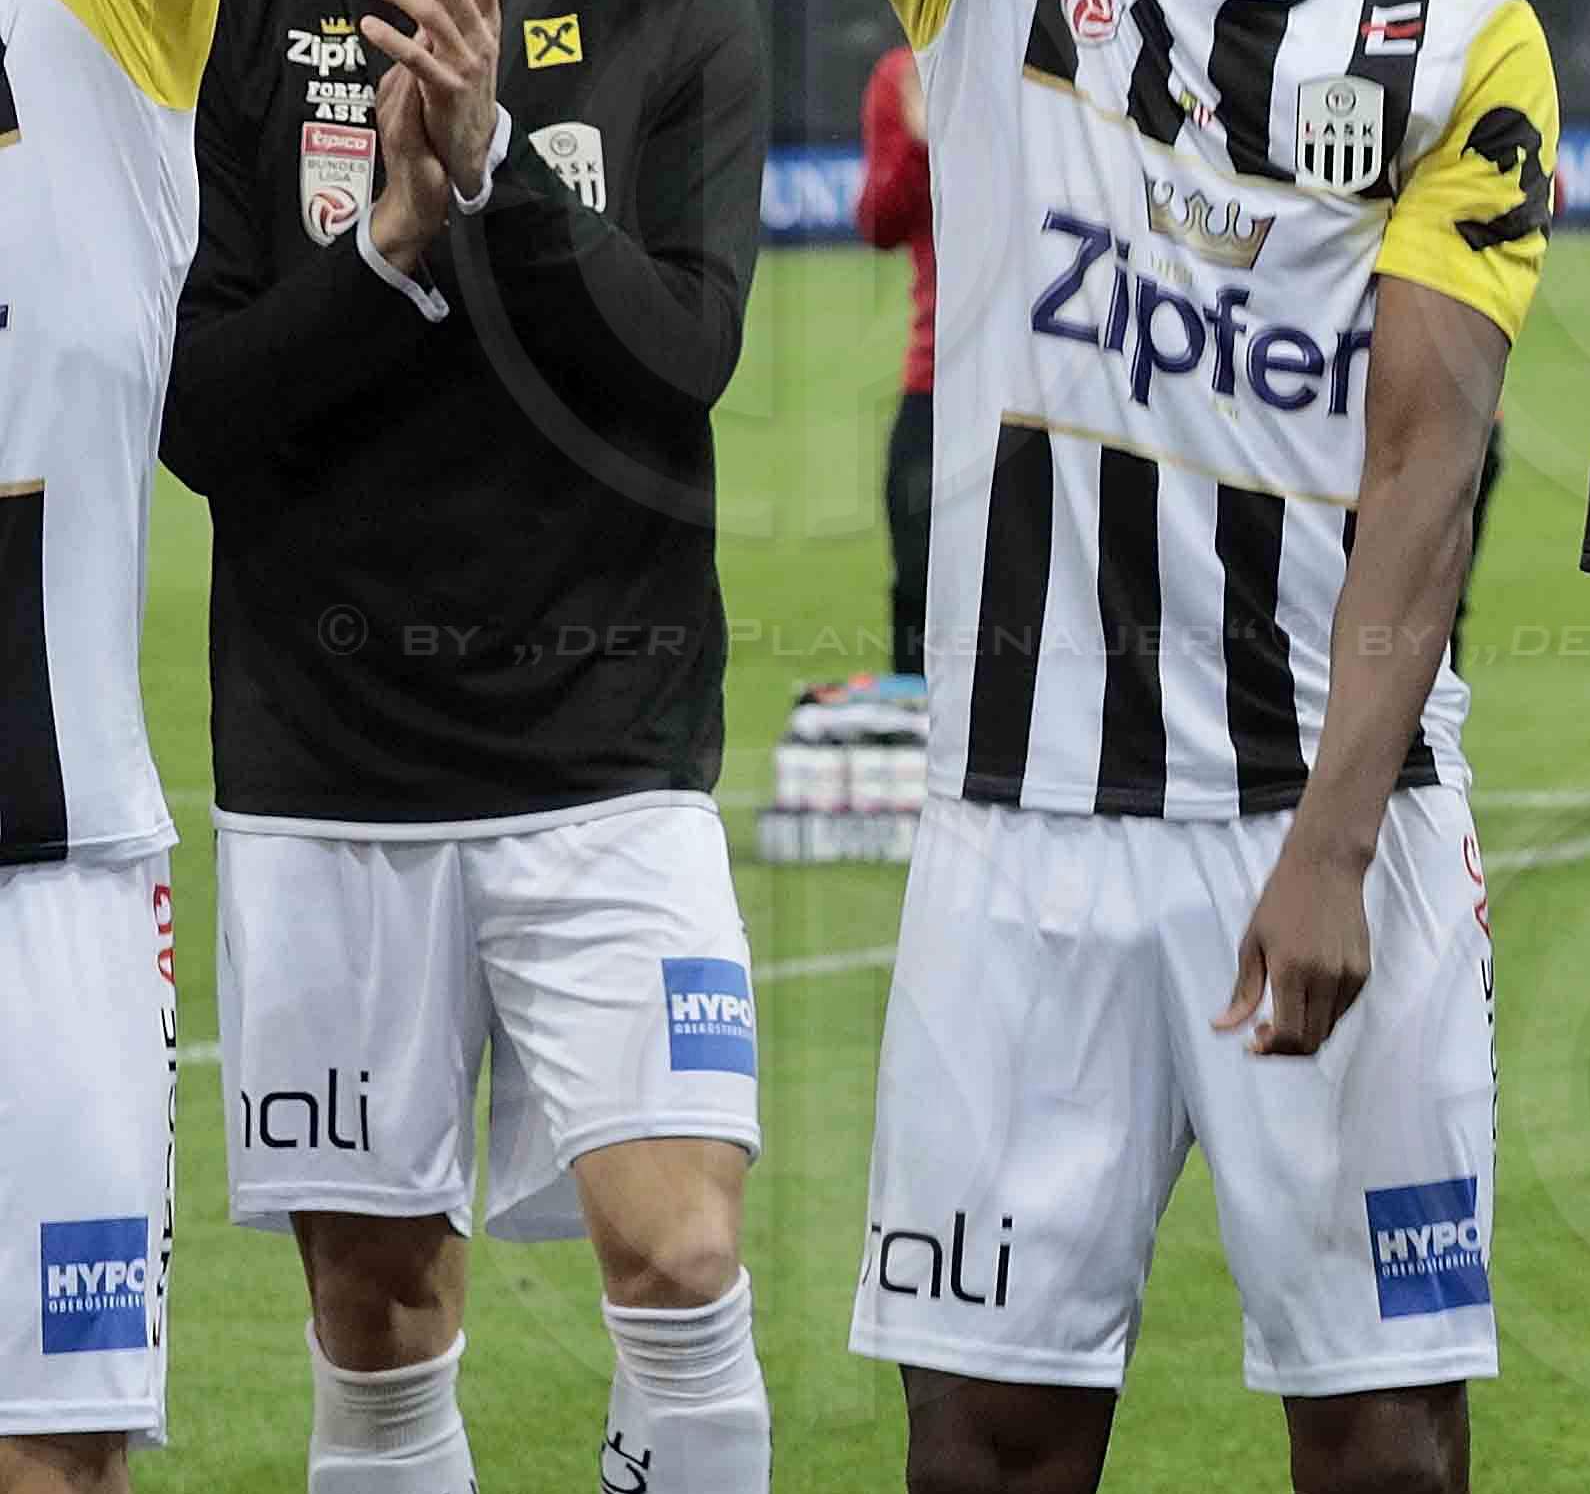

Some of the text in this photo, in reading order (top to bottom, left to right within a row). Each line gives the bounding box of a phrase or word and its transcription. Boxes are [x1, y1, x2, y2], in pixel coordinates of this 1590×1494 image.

[315, 105, 368, 123] ASK
[1304, 121, 1375, 139] LASK
[553, 162, 598, 176] ASK
[1031, 209, 1374, 417] Zipfer
[671, 992, 753, 1027] HYPO
[1376, 1218, 1483, 1262] HYPO
[47, 1258, 147, 1297] HYPO
[871, 1211, 1013, 1308] ali
